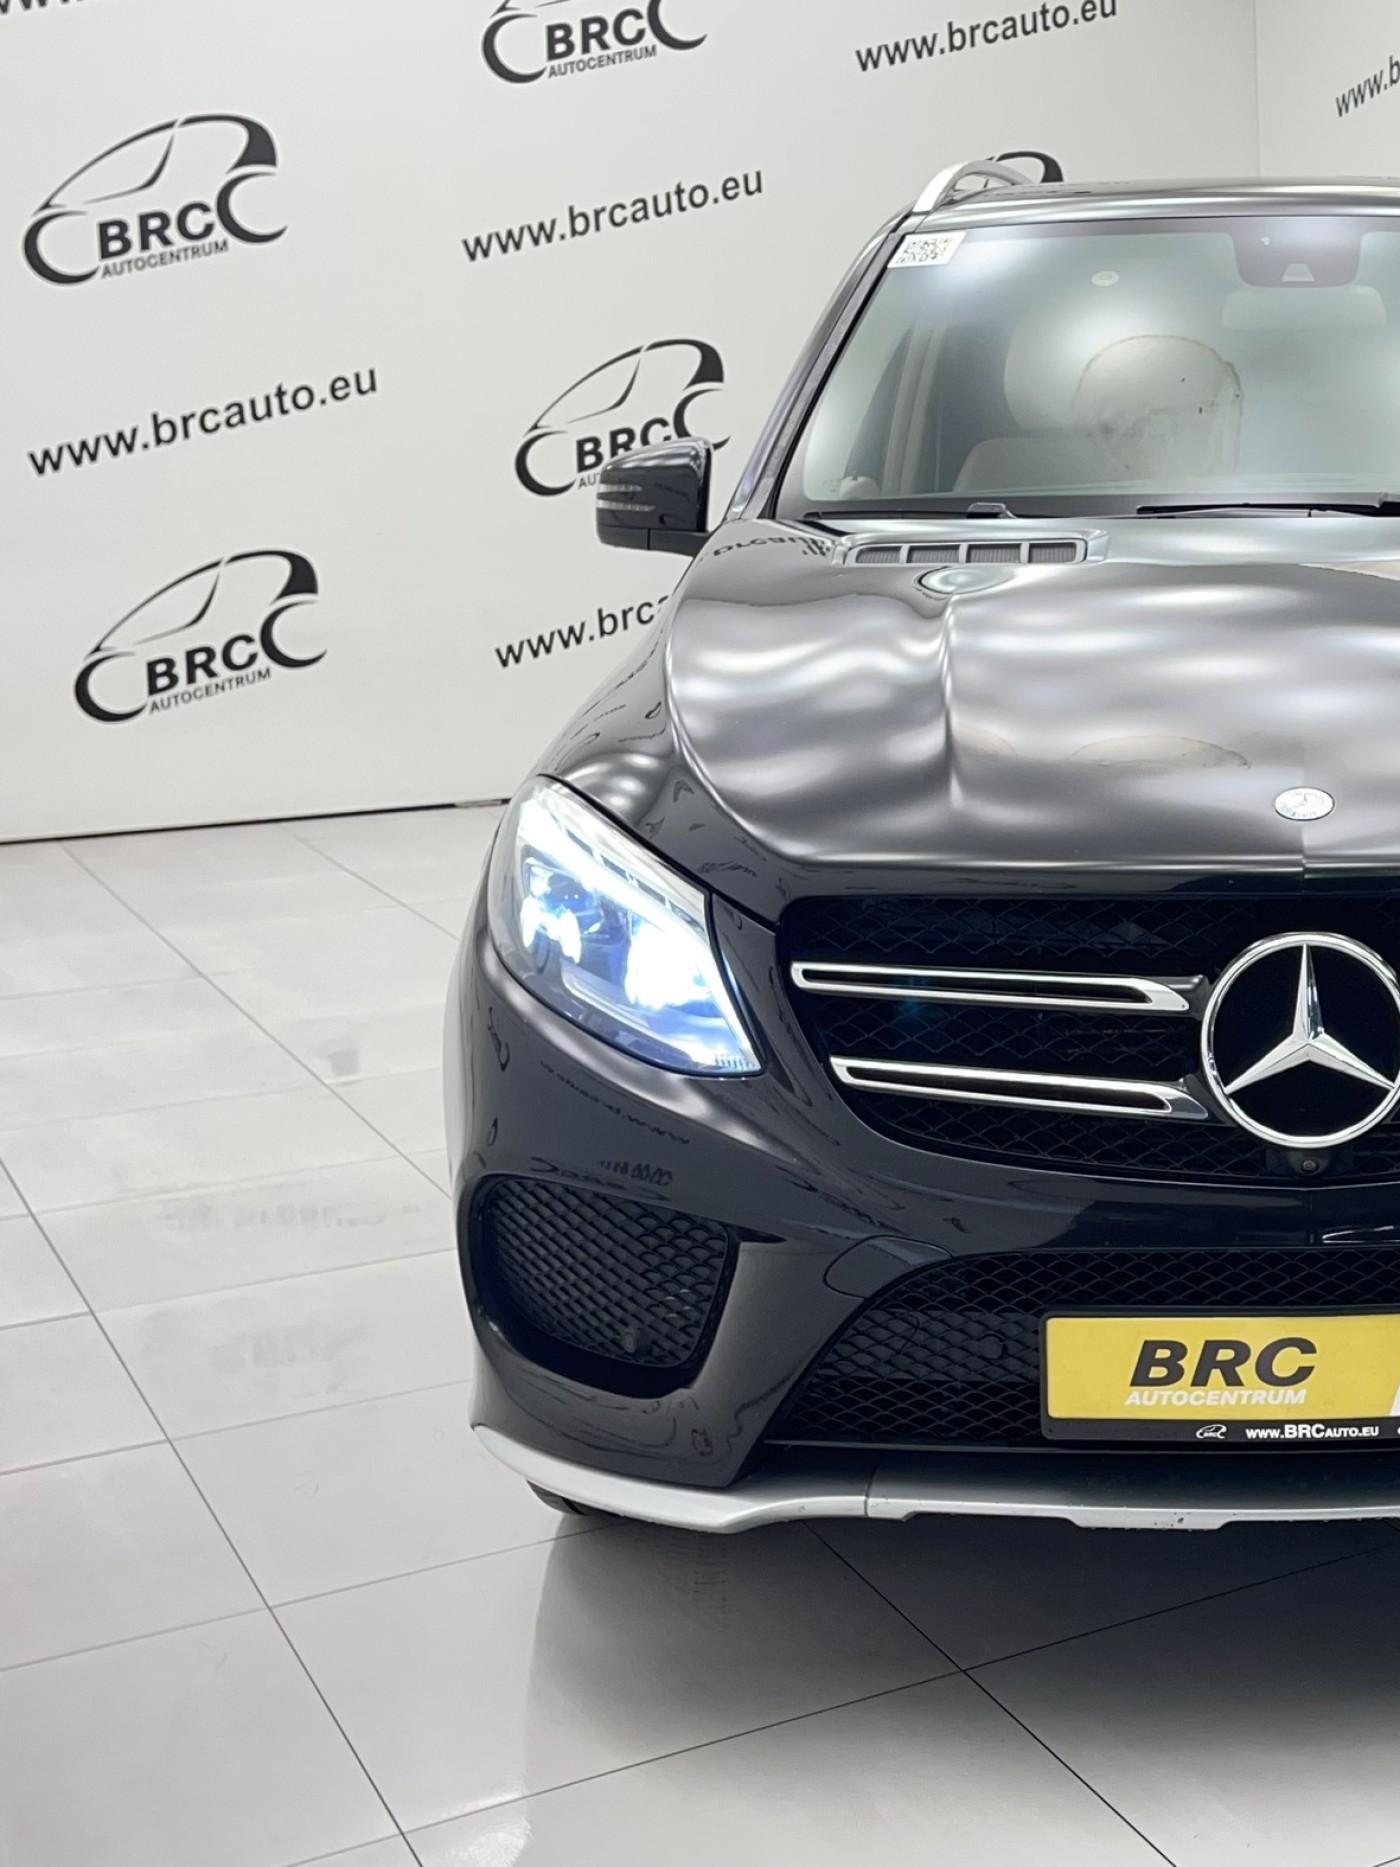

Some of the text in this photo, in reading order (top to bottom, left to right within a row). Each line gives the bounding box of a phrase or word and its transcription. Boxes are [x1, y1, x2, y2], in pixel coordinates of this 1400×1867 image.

[546, 8, 646, 62] BRC
[548, 44, 658, 79] AUTOCENTRUM
[856, 0, 1117, 71] www.brcauto.eu
[98, 201, 215, 261] BRC
[462, 170, 762, 262] www.brcauto.eu
[101, 238, 229, 278] AUTOCENTRUM
[28, 368, 377, 476] www.brcauto.eu
[495, 595, 669, 668] www.brc
[146, 633, 258, 697] BRC
[148, 665, 272, 715] AUTOCENTRUM
[1129, 1336, 1318, 1387] BRC
[1125, 1389, 1307, 1407] AUTOCENTRUM
